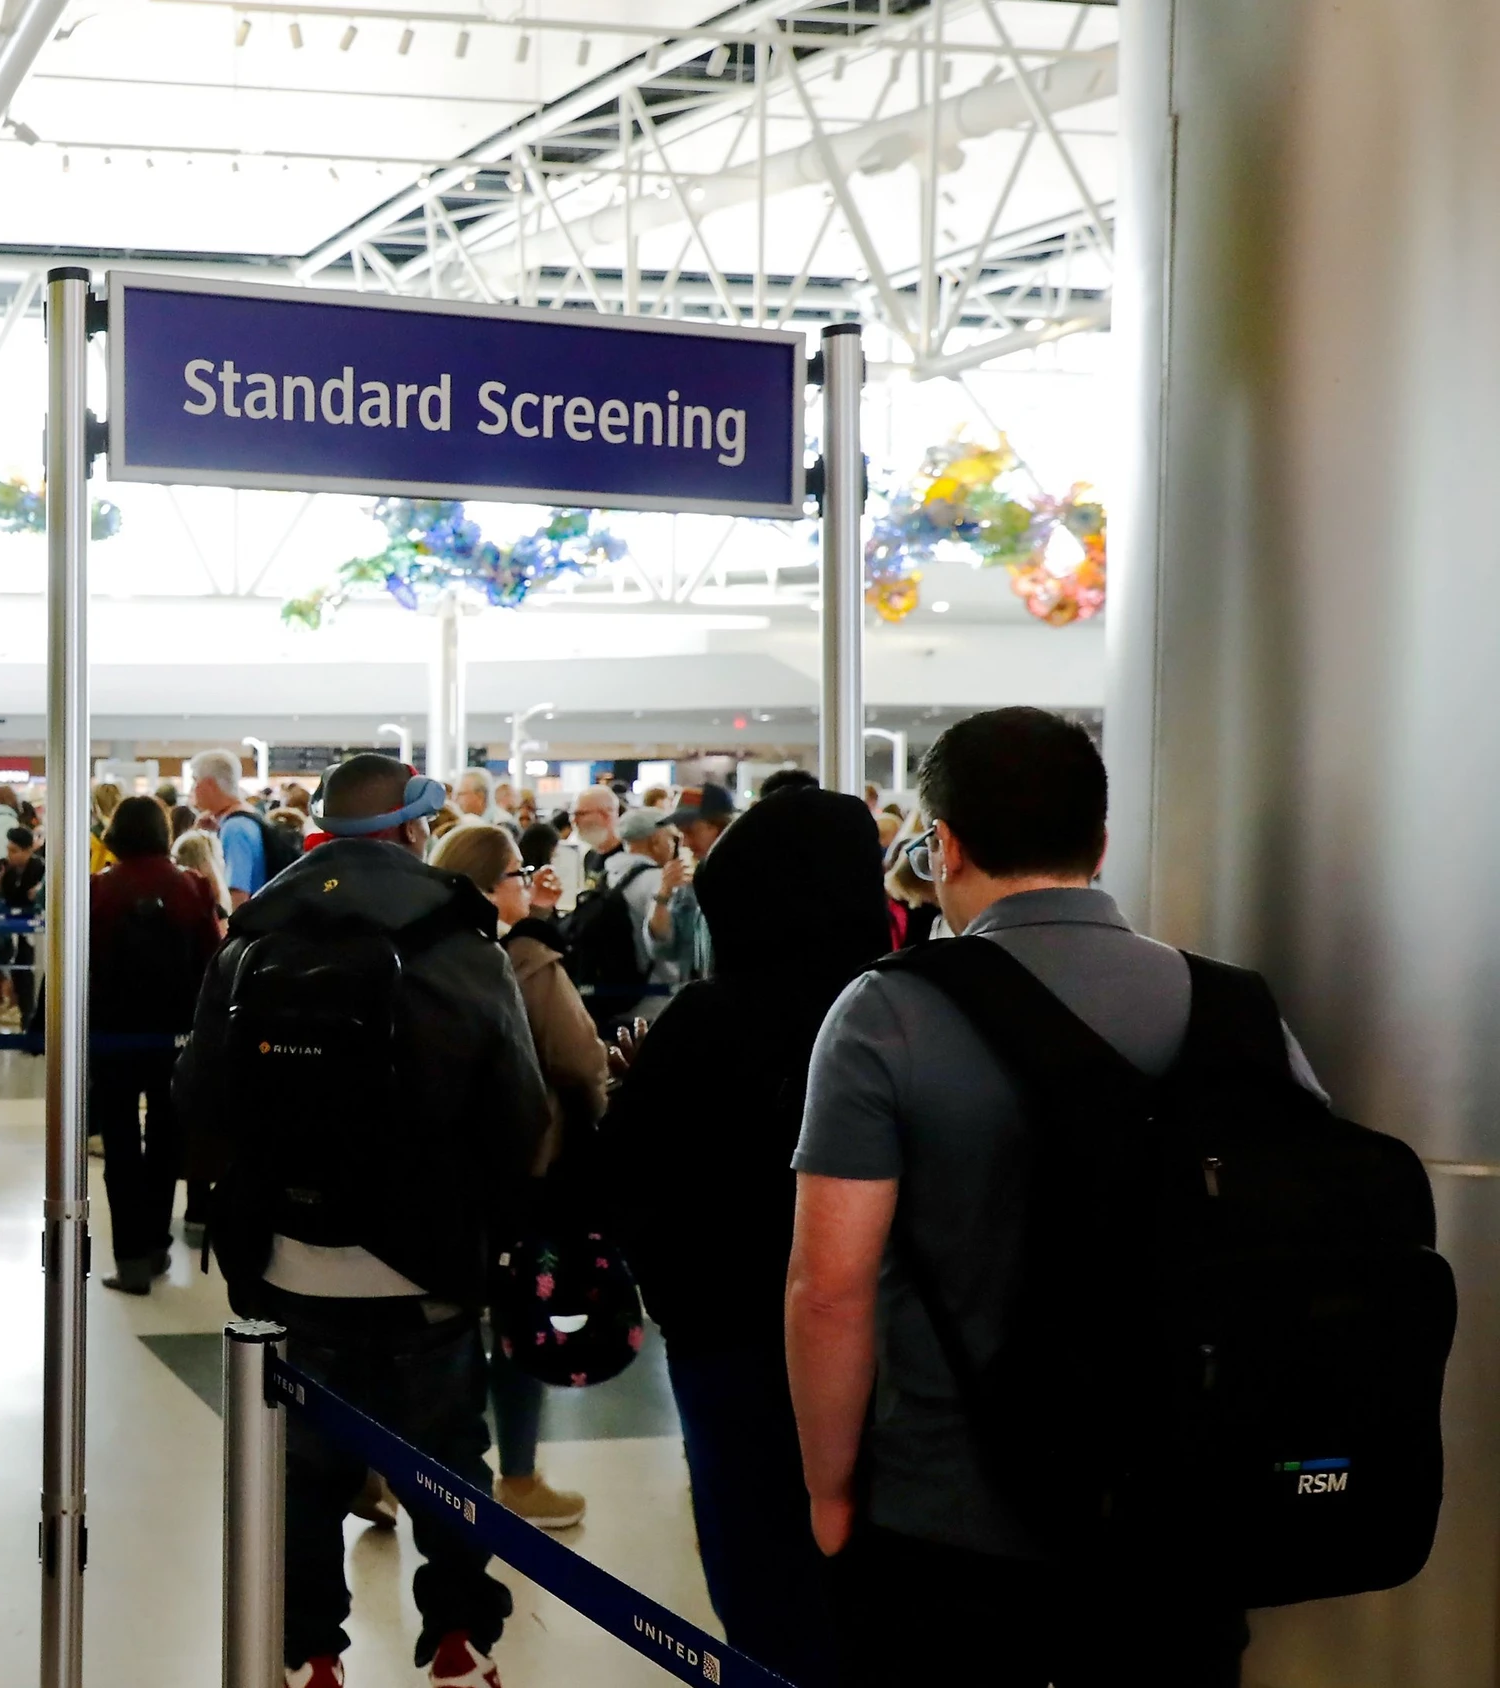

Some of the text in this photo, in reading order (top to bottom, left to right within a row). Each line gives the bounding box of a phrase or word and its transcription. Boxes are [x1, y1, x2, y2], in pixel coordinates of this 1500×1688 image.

[182, 358, 746, 467] Standard Screening
[273, 1044, 322, 1055] RIVIAN
[273, 1372, 295, 1394] ITED
[416, 1471, 461, 1510] UNITED
[1298, 1472, 1348, 1494] RSM
[633, 1614, 699, 1666] UNITED
